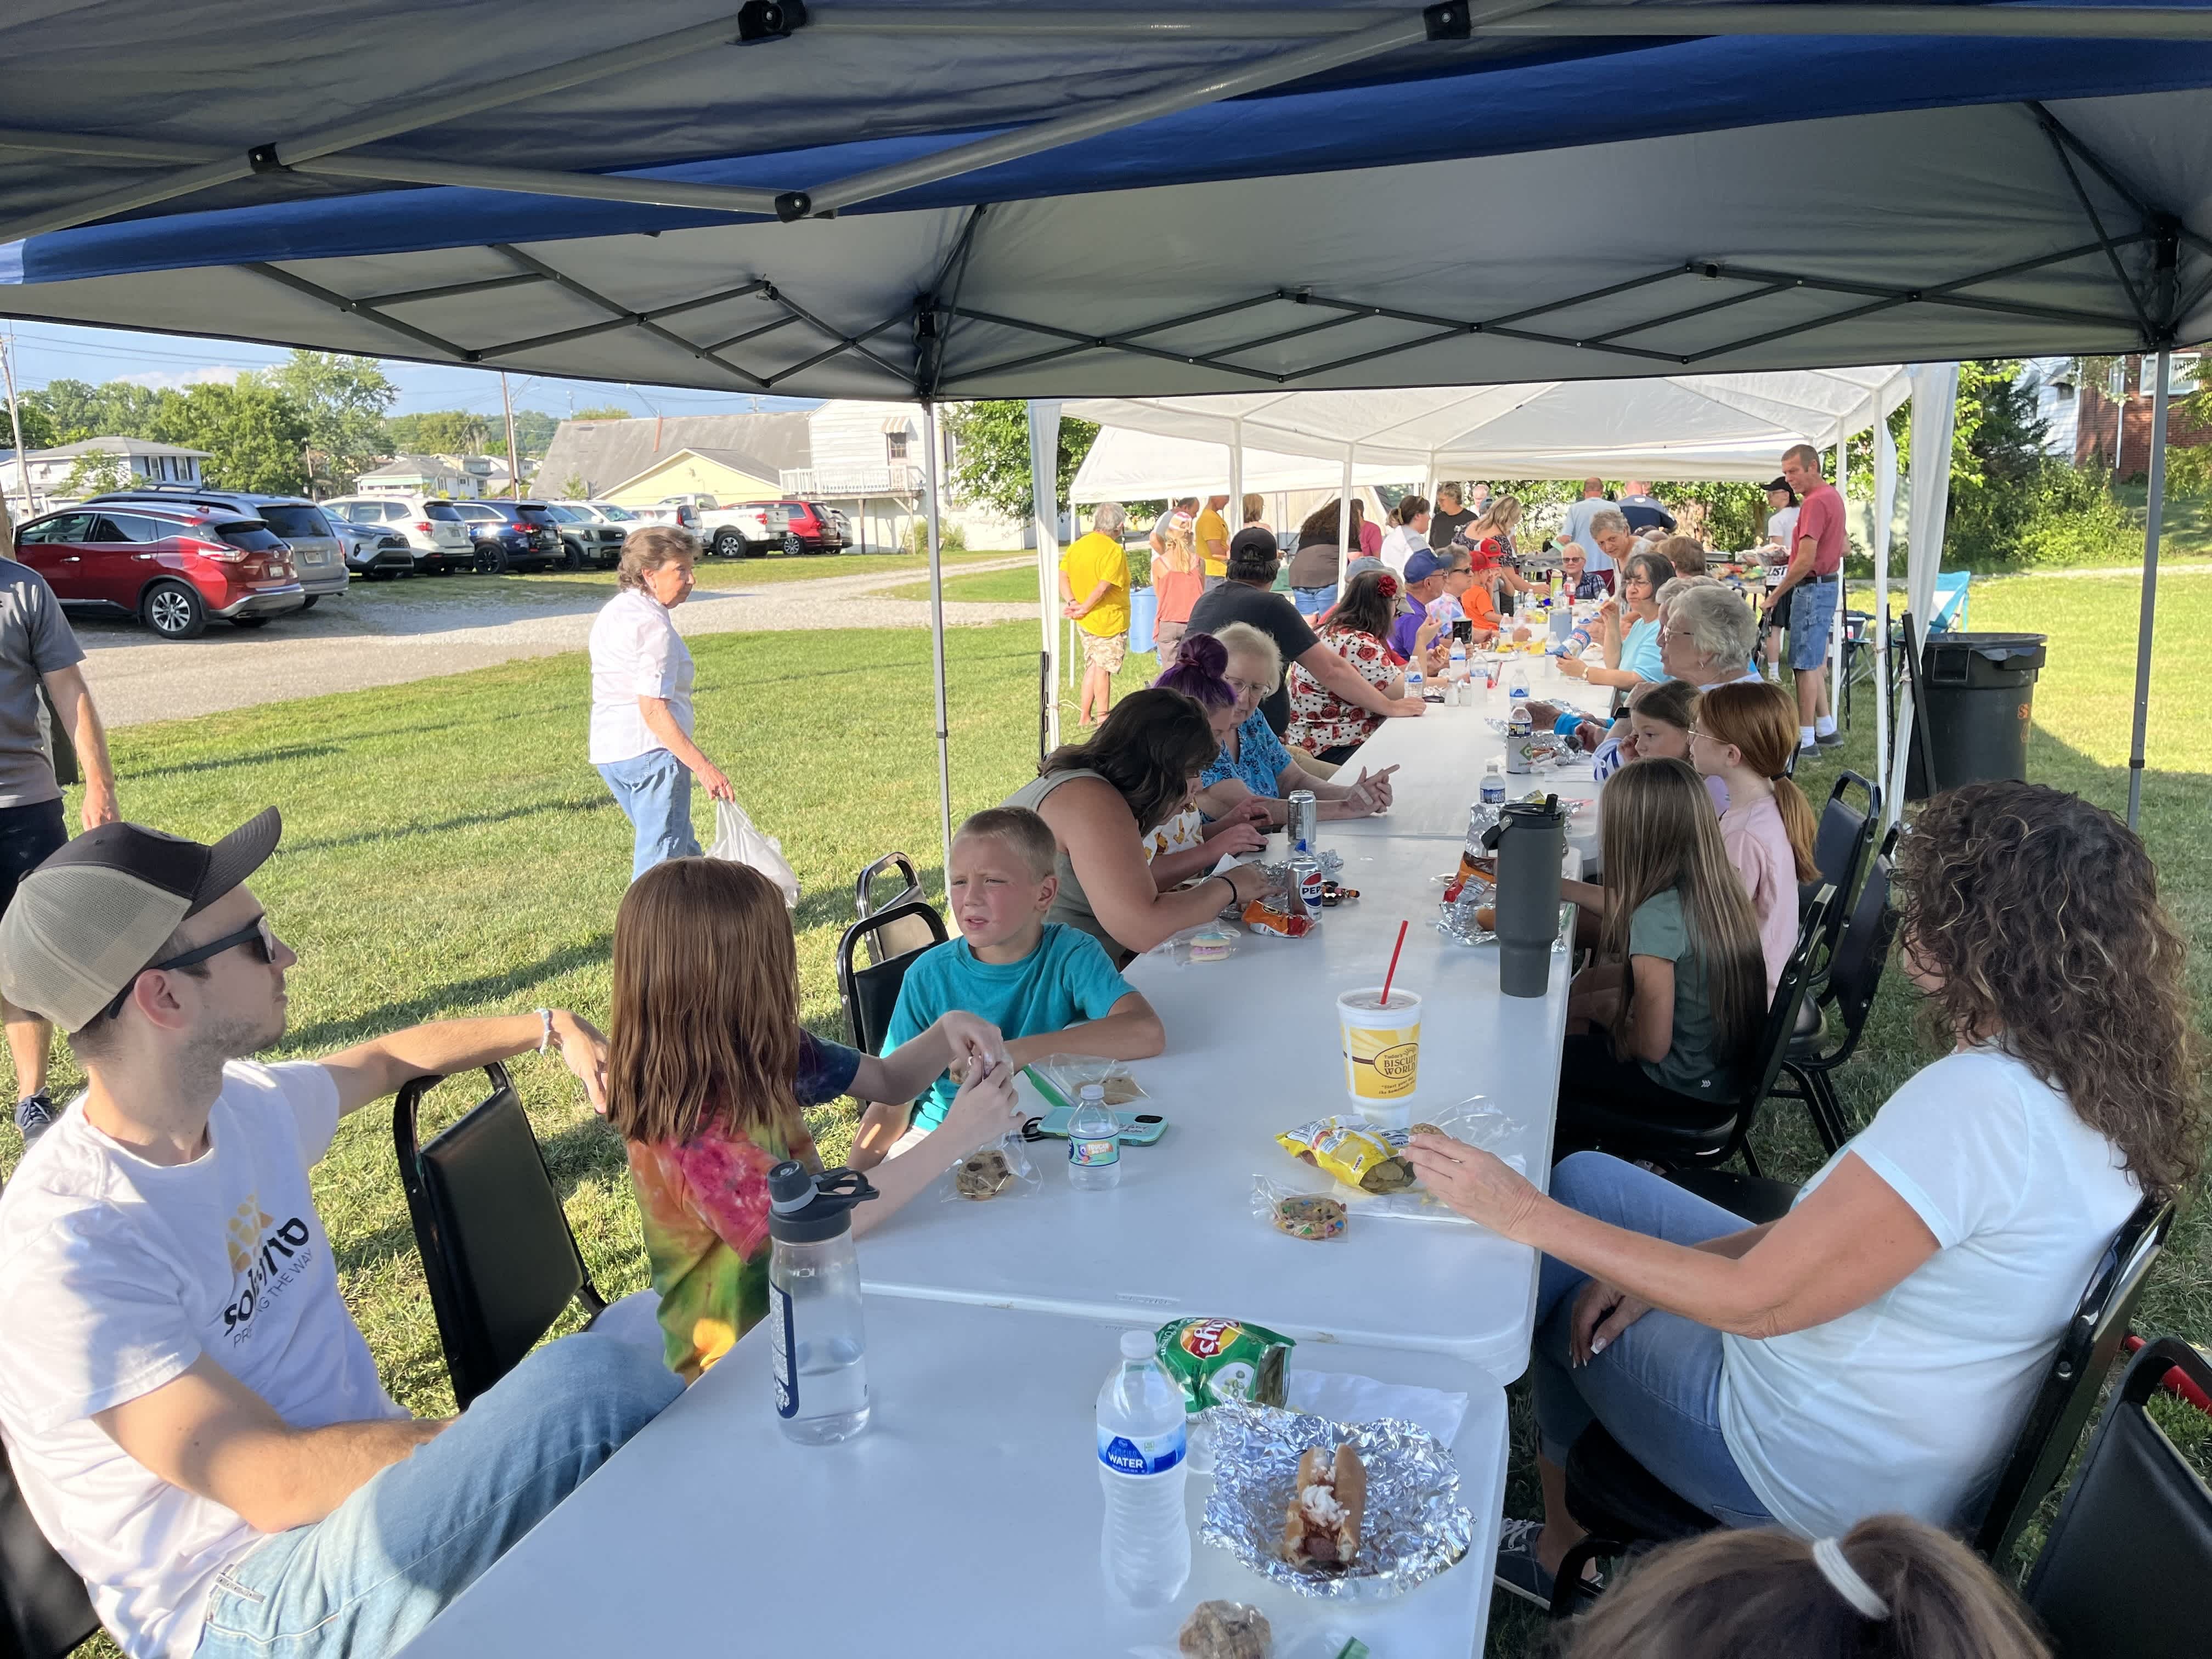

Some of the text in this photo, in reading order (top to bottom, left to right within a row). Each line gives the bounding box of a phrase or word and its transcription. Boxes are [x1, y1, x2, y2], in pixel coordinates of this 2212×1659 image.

[1384, 1054, 1416, 1068] BISCUIT
[1384, 1062, 1415, 1075] WORLD
[267, 1248, 312, 1297] THE WAY
[1108, 1452, 1143, 1469] WATER
